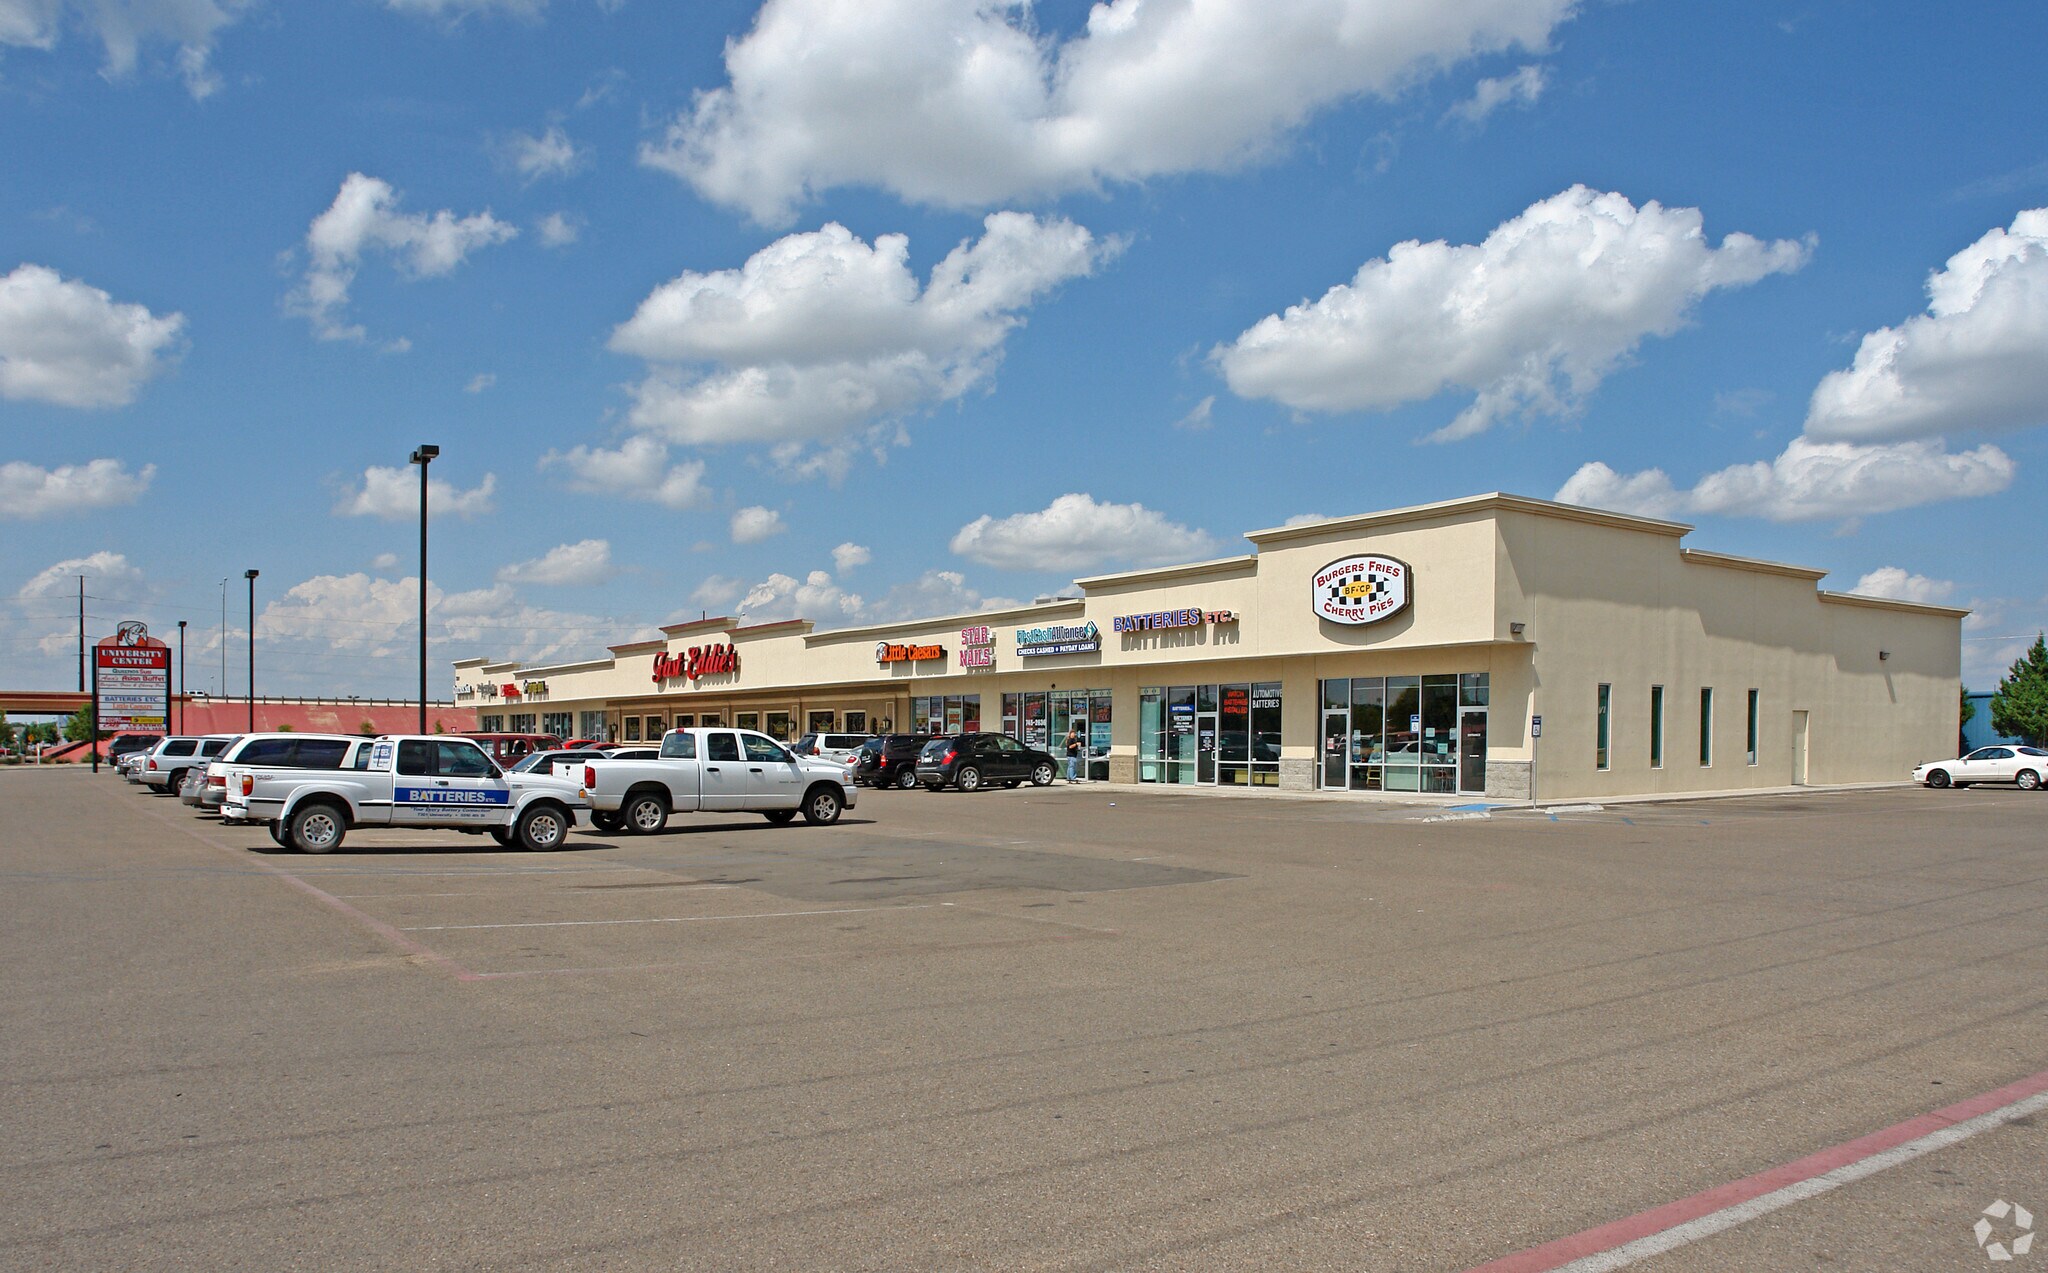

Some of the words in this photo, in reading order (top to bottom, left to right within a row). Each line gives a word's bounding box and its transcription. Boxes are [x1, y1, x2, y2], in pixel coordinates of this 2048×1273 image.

[1317, 563, 1365, 587] BURGERS
[1368, 561, 1400, 577] FRIES
[1113, 607, 1200, 633] BATTERIES
[1204, 609, 1232, 624] ETC.
[1323, 602, 1365, 621] CHERRY
[961, 625, 990, 646] STAR
[101, 649, 163, 658] UNIVERSITY
[882, 644, 907, 662] Little
[907, 644, 942, 661] Caesars
[960, 647, 992, 667] NAILS
[1018, 647, 1036, 655] CHECKS
[1036, 646, 1055, 654] CASHED
[1059, 644, 1078, 652] PAYDAY
[1078, 643, 1095, 651] LOANS
[112, 657, 153, 665] CENTER
[652, 651, 686, 683] Fast
[1252, 689, 1283, 698] AUTOMOTIVE
[1252, 699, 1280, 709] BATTERIES
[409, 790, 486, 803] BATTERIES
